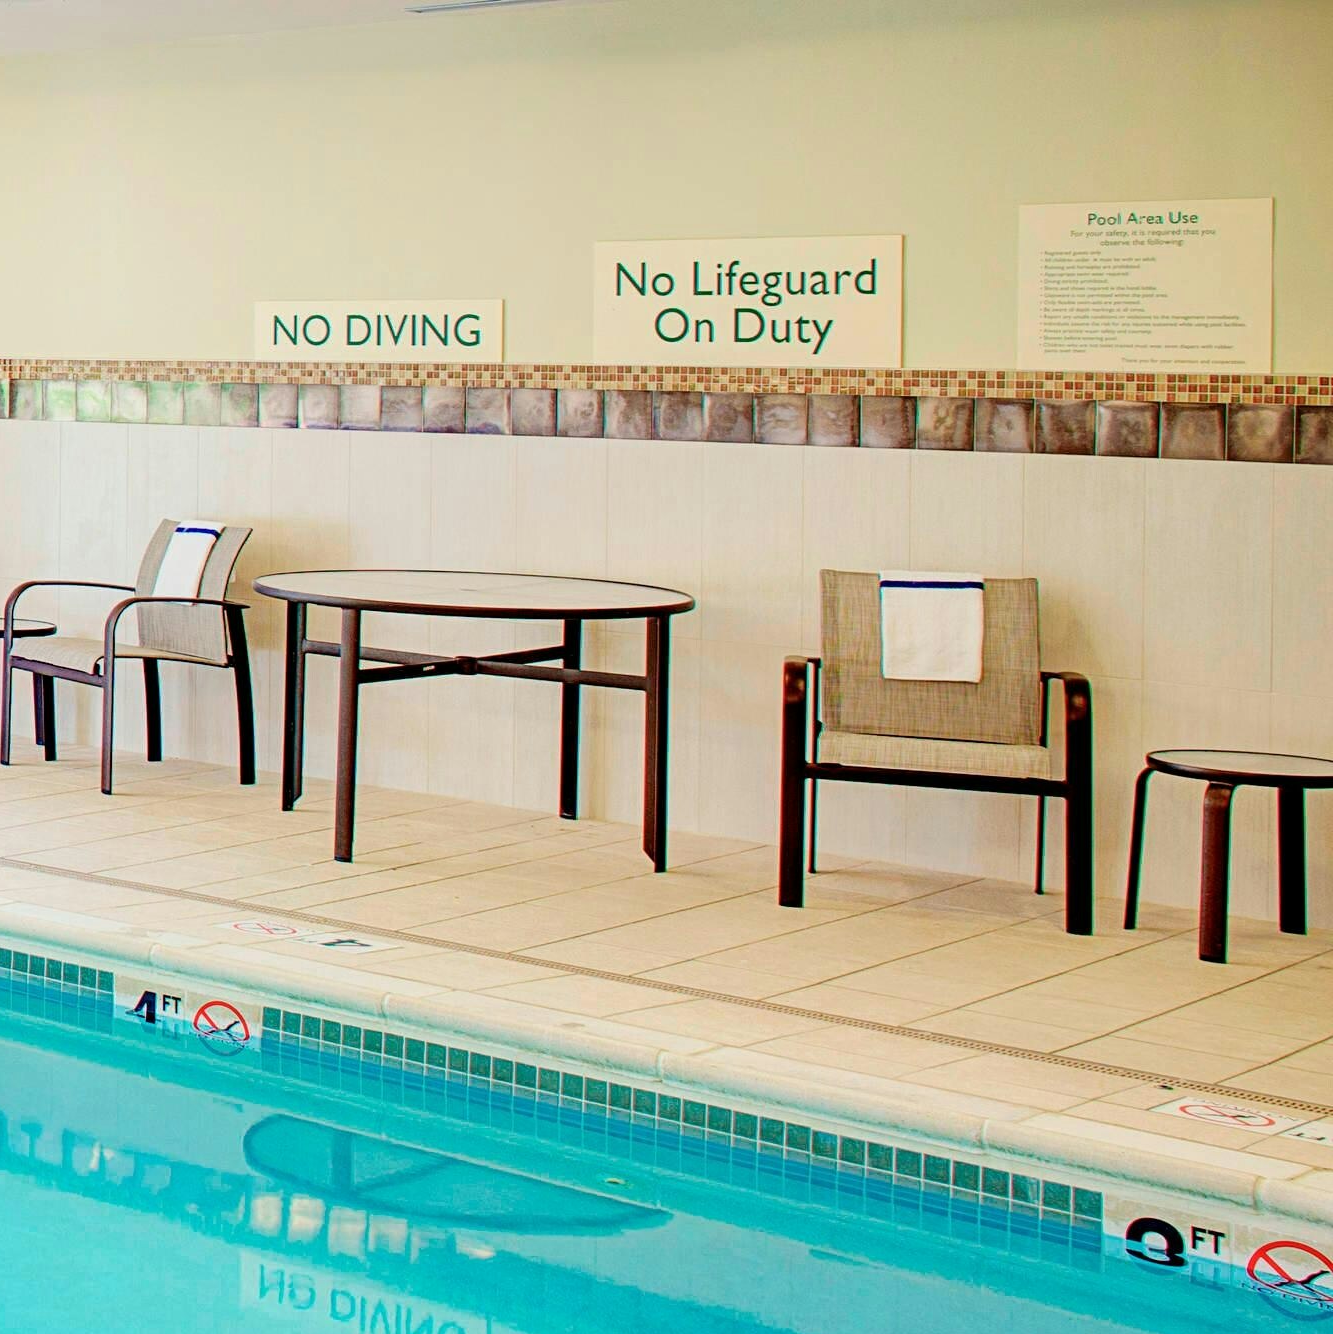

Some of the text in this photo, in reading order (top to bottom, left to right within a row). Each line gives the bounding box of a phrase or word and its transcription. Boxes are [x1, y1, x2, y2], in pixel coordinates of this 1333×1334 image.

[1087, 211, 1199, 225] Pool Area Use
[1147, 228, 1181, 238] required
[616, 258, 878, 307] No Lifeguard
[272, 313, 482, 347] NO DIVING
[655, 308, 833, 355] On Duty
[162, 993, 182, 1015] FT
[1190, 1225, 1226, 1255] FT
